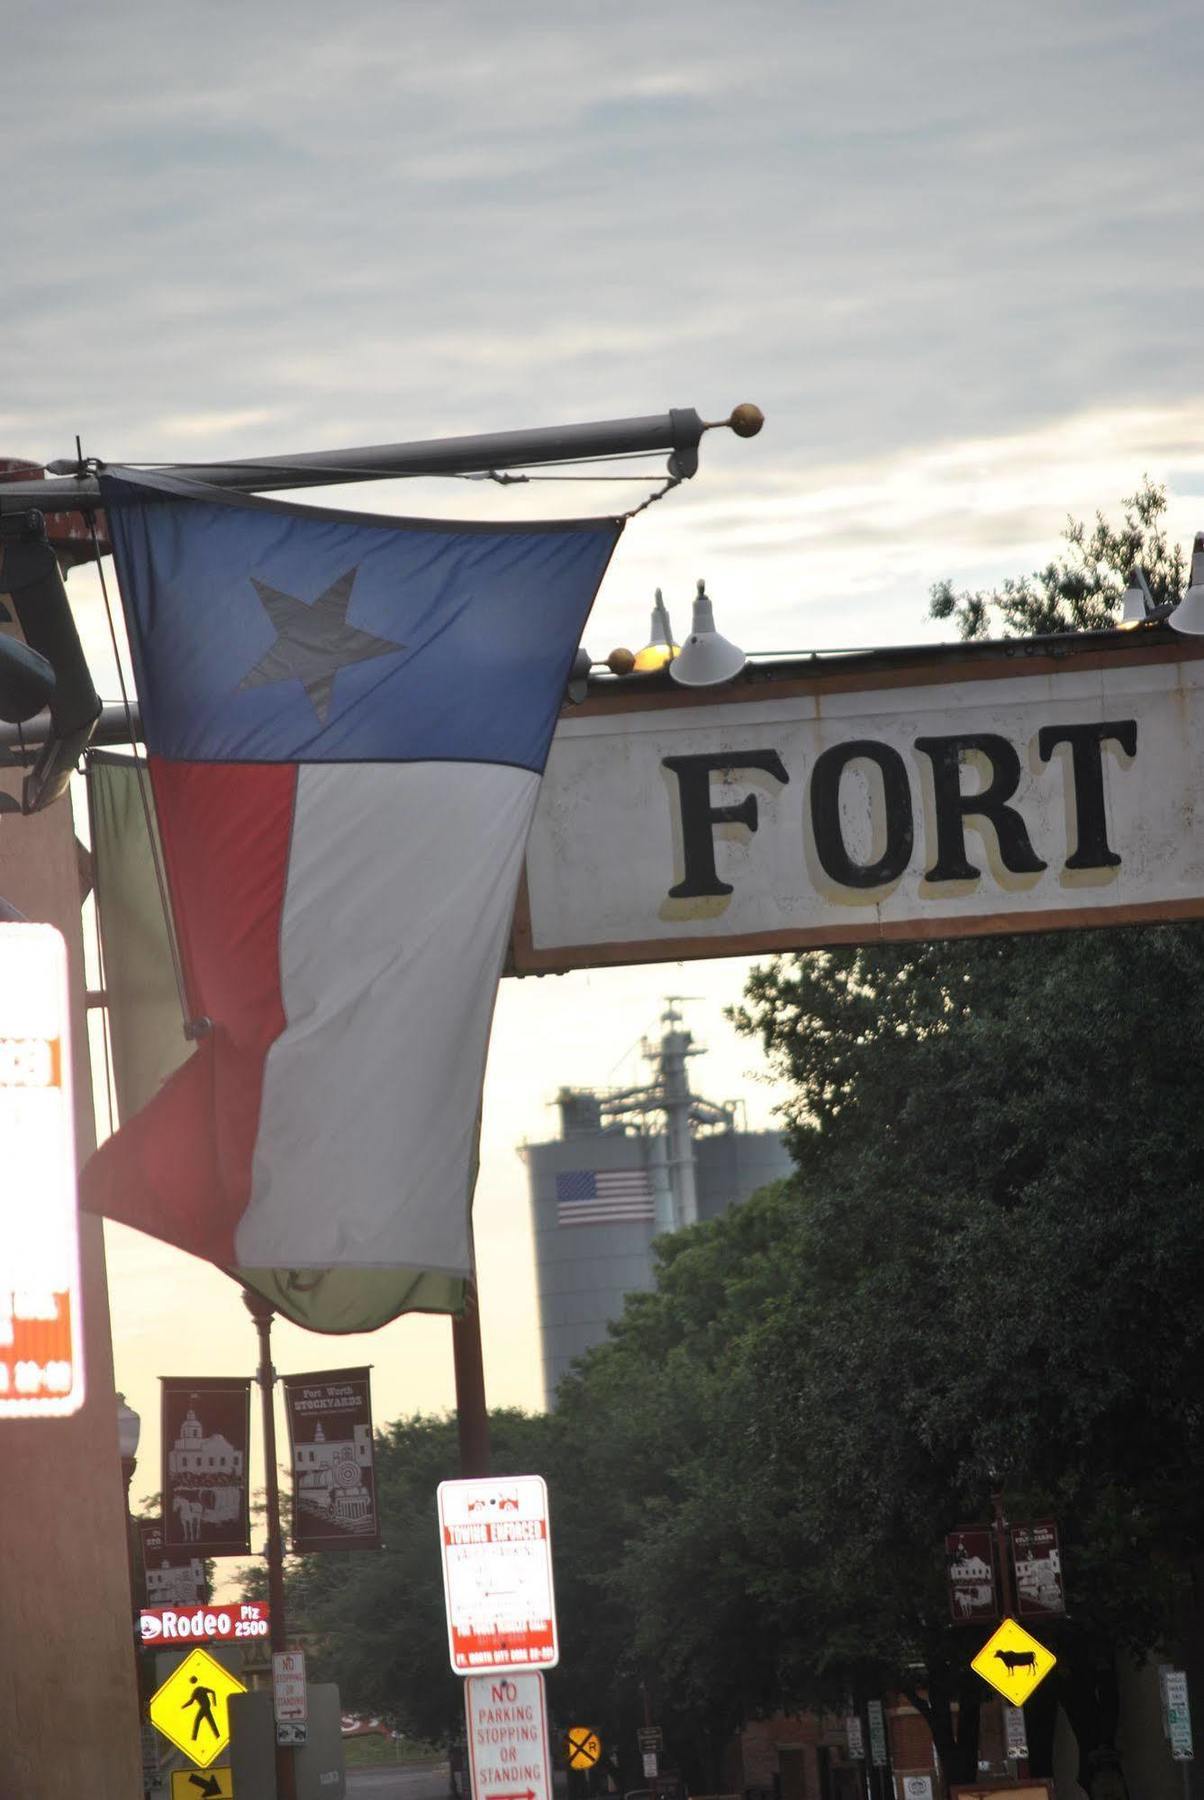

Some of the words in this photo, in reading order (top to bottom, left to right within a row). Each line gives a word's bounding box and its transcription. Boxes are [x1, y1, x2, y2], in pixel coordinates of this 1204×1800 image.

[660, 719, 1138, 905] FORT
[294, 1396, 362, 1411] STOCKYARDS
[162, 1609, 231, 1638] Rodeo
[235, 1620, 268, 1637] 2500
[491, 1683, 517, 1703] NO
[478, 1706, 533, 1723] PARKING
[477, 1725, 537, 1745] STOPPING
[500, 1747, 517, 1763] OR
[480, 1765, 541, 1785] STANDING
